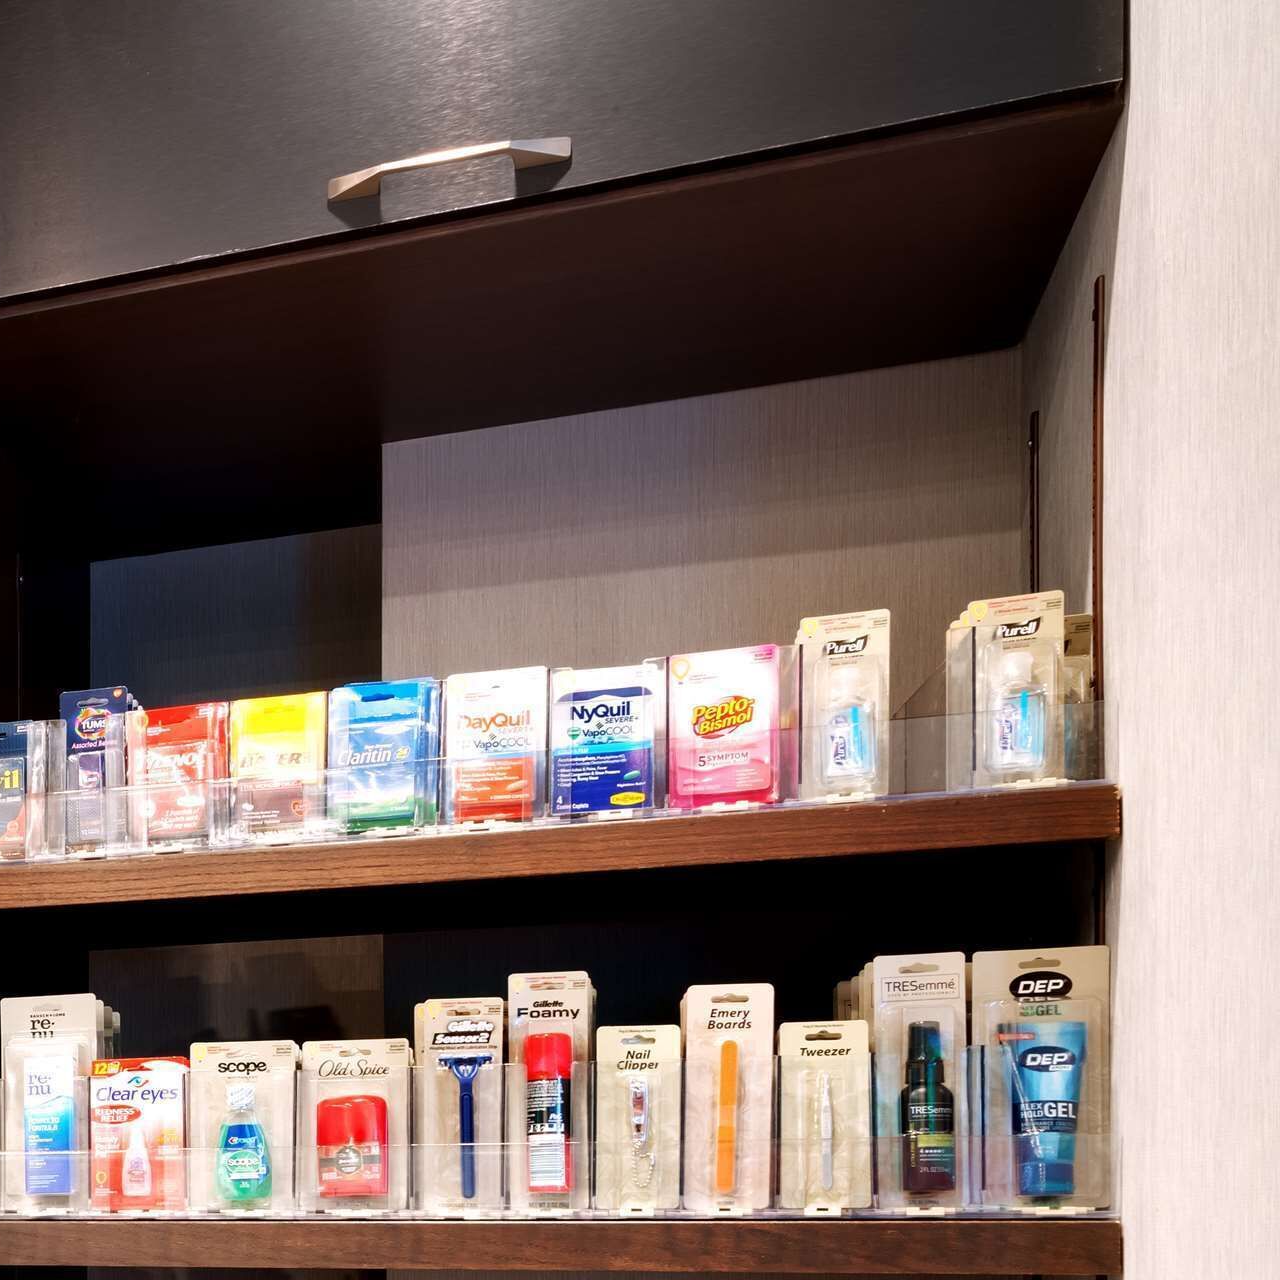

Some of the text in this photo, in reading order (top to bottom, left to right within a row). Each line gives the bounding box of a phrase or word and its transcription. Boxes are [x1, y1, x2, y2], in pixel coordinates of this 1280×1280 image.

[570, 702, 631, 723] NyQuil
[1017, 978, 1064, 996] DEP
[517, 1007, 581, 1021] Foamy
[709, 1008, 751, 1021] Emery
[707, 1019, 753, 1031] Boards
[626, 1050, 652, 1060] Nail
[800, 1047, 852, 1058] Tweezer
[1025, 1052, 1069, 1067] DEP
[217, 1060, 268, 1077] scope
[318, 1058, 390, 1079] Old Spice
[616, 1060, 659, 1071] Clipper
[96, 1085, 178, 1105] Clear eyes
[1044, 1102, 1077, 1120] GEL
